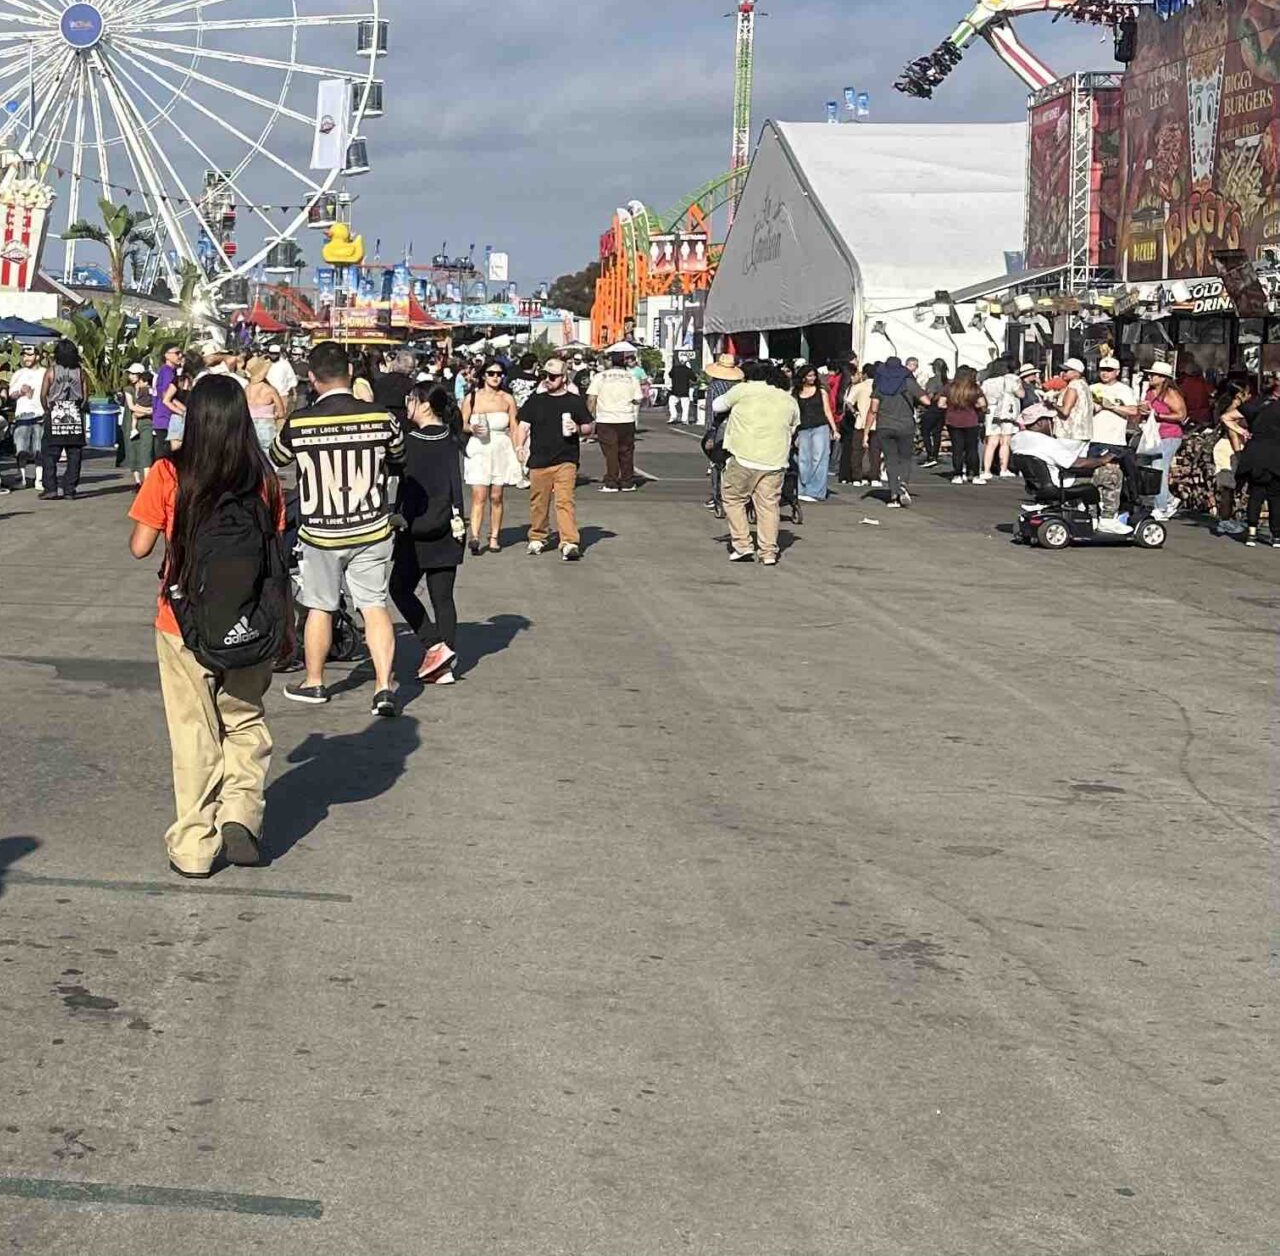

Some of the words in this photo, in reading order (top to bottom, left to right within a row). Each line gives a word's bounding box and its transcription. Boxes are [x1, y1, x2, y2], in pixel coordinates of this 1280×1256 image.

[1224, 86, 1273, 117] BURGERS
[1165, 191, 1243, 258] BIGGY'S
[1193, 297, 1234, 313] DRIN
[223, 629, 260, 645] adidas
